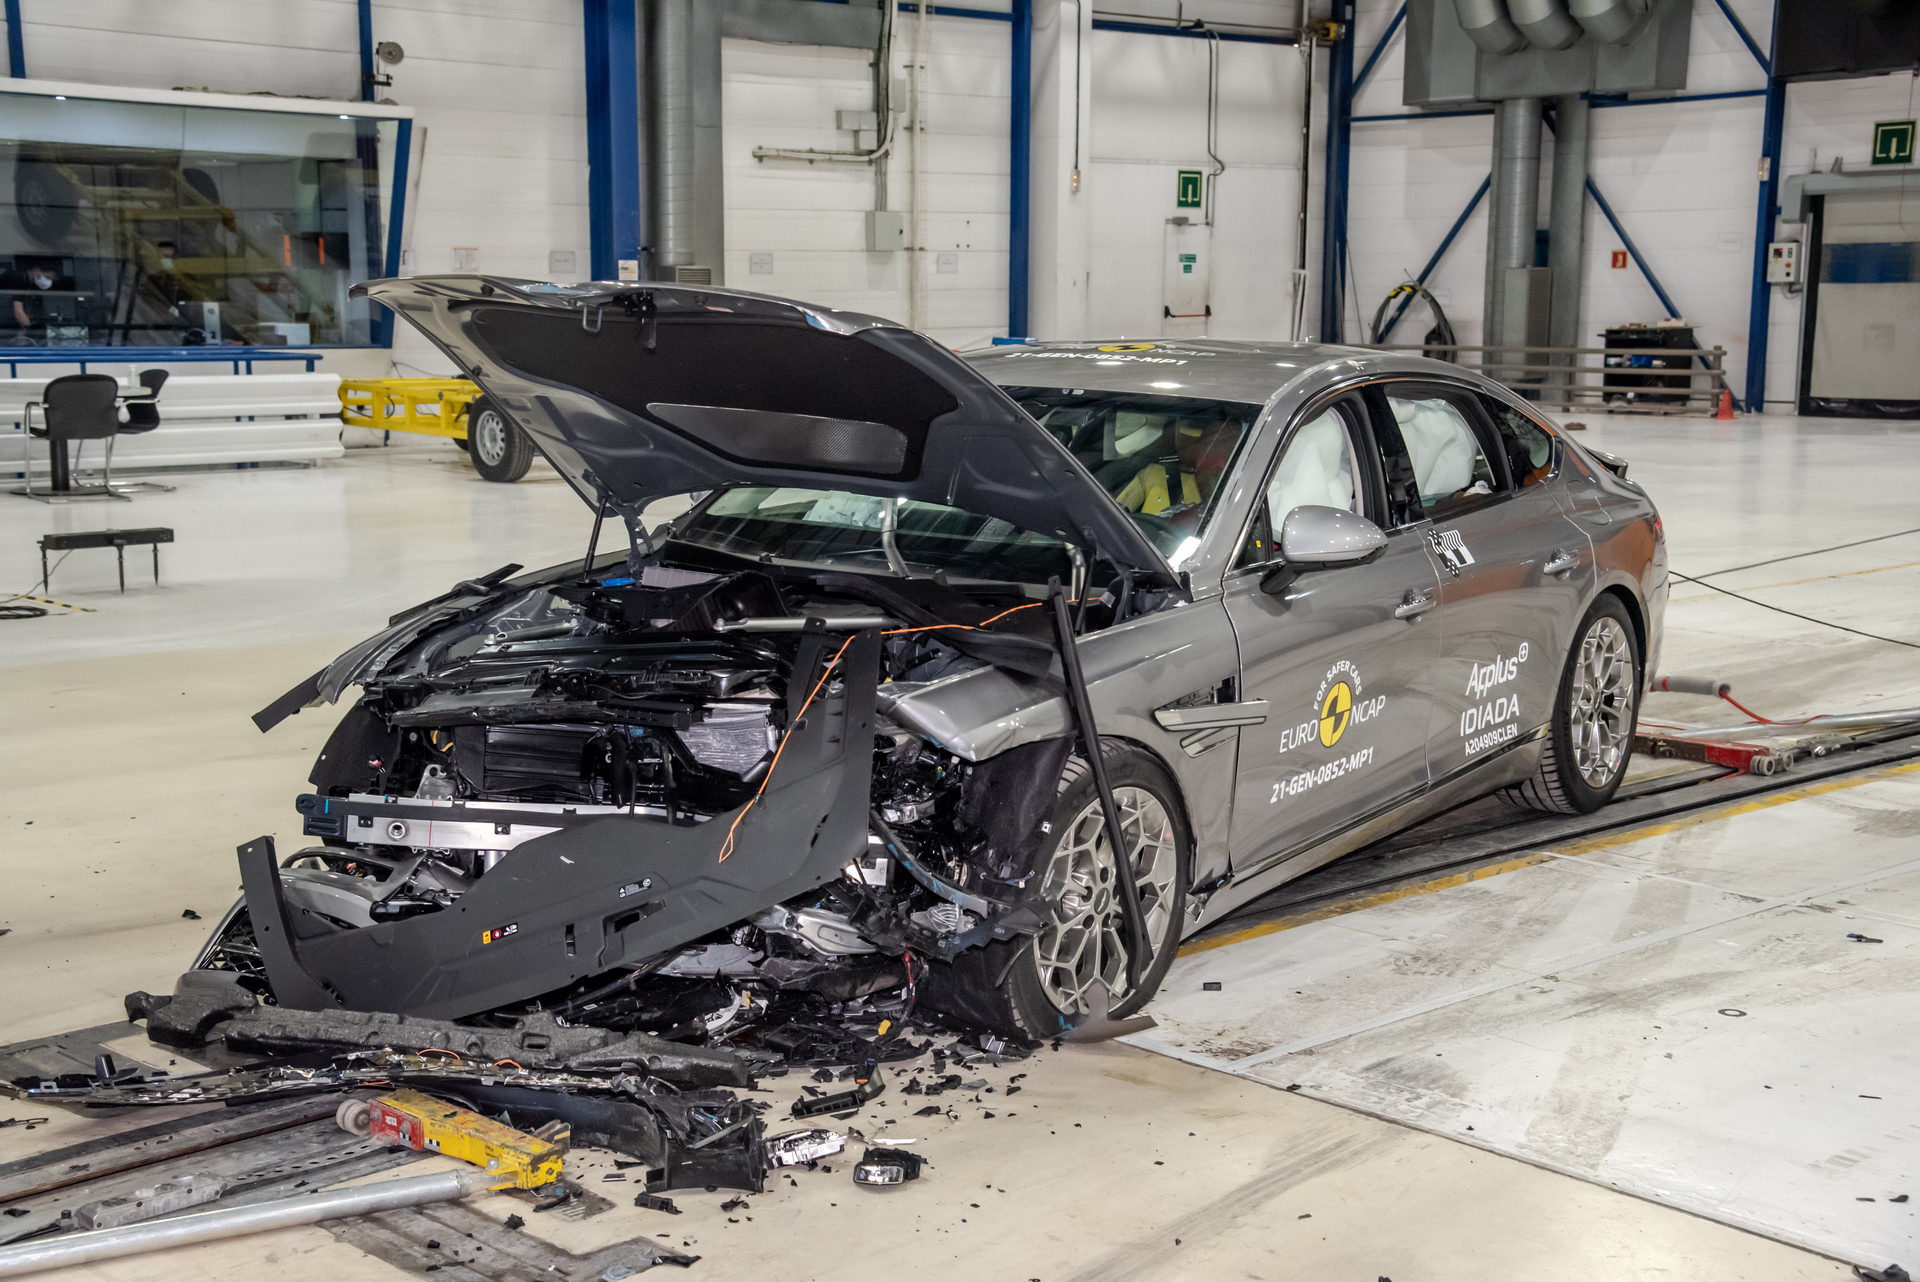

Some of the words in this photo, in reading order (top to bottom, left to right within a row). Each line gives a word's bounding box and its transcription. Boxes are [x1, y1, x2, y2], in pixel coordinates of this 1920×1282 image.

[1004, 352, 1188, 365] 21-GEN-0852-MP1
[1313, 681, 1327, 710] FOR
[1326, 660, 1350, 682] SAFER
[1350, 665, 1361, 695] CARS
[1280, 719, 1318, 753] EURO
[1350, 695, 1385, 727] NCAP
[1460, 693, 1520, 737] IDIADA
[1465, 723, 1518, 756] A204909CLEN
[1270, 746, 1374, 804] 21-GEN-0852-MP1
